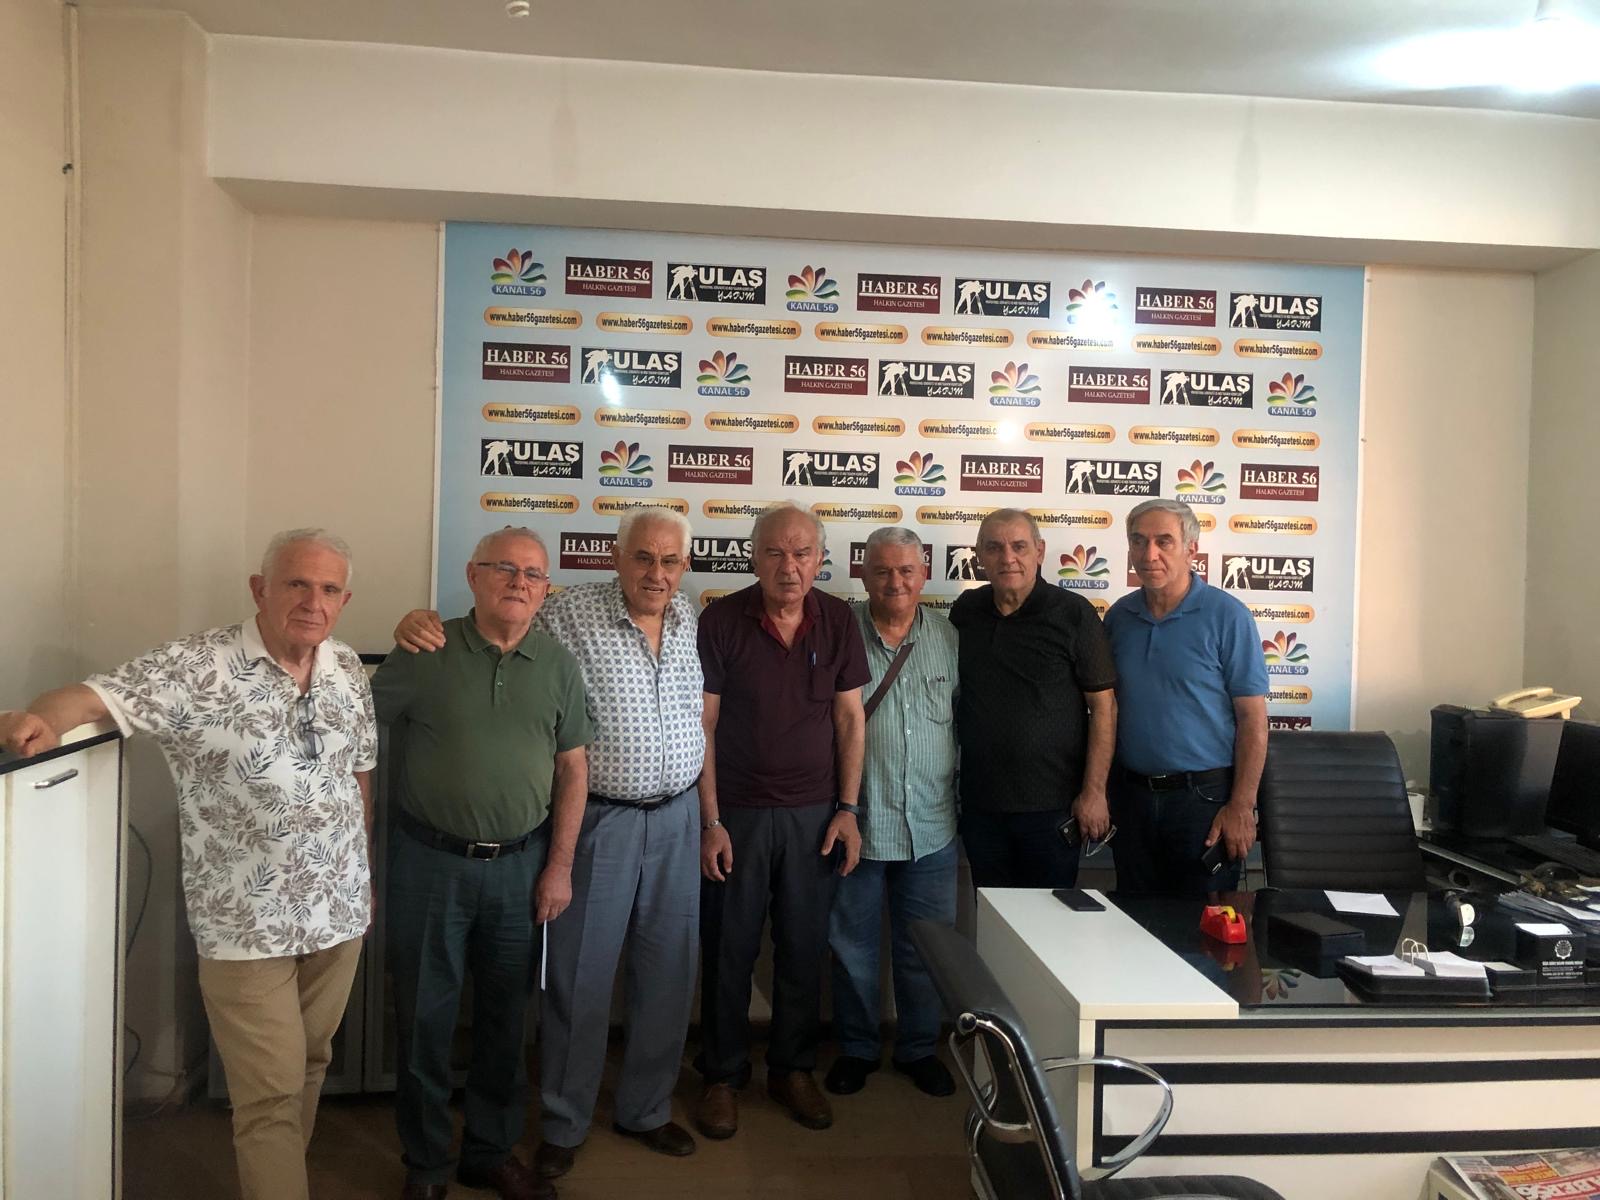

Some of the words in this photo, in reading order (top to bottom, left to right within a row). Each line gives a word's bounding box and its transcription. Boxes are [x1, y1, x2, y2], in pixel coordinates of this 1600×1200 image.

[569, 263, 629, 280] HABER
[633, 266, 650, 281] 56
[699, 267, 763, 288] ULAŞ
[495, 285, 528, 296] KANAL
[529, 286, 542, 296] 56
[582, 282, 606, 292] HALKIN
[860, 279, 917, 295] HABER
[921, 282, 938, 296] 56
[985, 282, 1048, 303] ULAŞ
[790, 302, 822, 312] KANAL
[823, 303, 835, 312] 56
[873, 299, 896, 308] HALKIN
[1139, 293, 1193, 309] HABER
[1198, 296, 1214, 310] 56
[1259, 296, 1319, 317] ULAŞ
[489, 312, 578, 326] www.haber56gazetesi.com
[1151, 312, 1173, 320] HALKIN
[601, 317, 688, 332] www.haber56gazetesi.com
[711, 322, 797, 337] www.haber56gazetesi.com
[820, 327, 904, 341] www.haber56gazetesi.com
[926, 331, 1009, 345] www.haber56gazetesi.com
[1136, 339, 1217, 352] www.haber56gazetesi.com
[1239, 343, 1318, 357] www.haber56gazetesi.com
[486, 349, 545, 365] HABER
[550, 351, 568, 366] 56
[613, 351, 679, 372] ULAŞ
[500, 368, 523, 376] HALKIN
[788, 361, 845, 377] HABER
[849, 364, 866, 378] 56
[909, 364, 971, 385] ULAŞ
[801, 381, 824, 389] HALKIN
[1072, 372, 1126, 387] HABER
[1132, 374, 1148, 388] 56
[1190, 374, 1250, 395] ULAŞ
[701, 386, 733, 396] KANAL
[734, 388, 746, 397] 56
[1084, 391, 1105, 399] HALKIN
[993, 397, 1025, 406] KANAL
[1026, 398, 1037, 406] 56
[487, 408, 576, 422] www.haber56gazetesi.com
[1271, 407, 1300, 416] KANAL
[1301, 407, 1313, 417] 56
[600, 412, 686, 427] www.haber56gazetesi.com
[709, 416, 795, 431] www.haber56gazetesi.com
[817, 420, 901, 434] www.haber56gazetesi.com
[924, 425, 997, 439] www.haber56gazetesi.c
[1029, 428, 1111, 442] www.haber56gazetesi.com
[1133, 430, 1215, 444] www.haber56gazetesi.com
[1237, 434, 1316, 448] www.haber56gazetesi.com
[514, 442, 580, 464] ULAŞ
[672, 451, 729, 467] HABER
[733, 453, 751, 467] 56
[814, 454, 876, 474] ULAŞ
[964, 461, 1020, 476] HABER
[1025, 463, 1041, 476] 56
[685, 470, 708, 479] HALKIN
[1096, 462, 1158, 484] ULAŞ
[1243, 470, 1297, 484] HABER
[1301, 471, 1317, 485] 56
[603, 477, 635, 487] KANAL
[636, 478, 648, 488] 56
[976, 479, 999, 487] HALKIN
[898, 486, 930, 496] KANAL
[930, 487, 942, 496] 56
[1255, 488, 1278, 496] HALKIN
[486, 496, 574, 510] www.haber56gazetesi.com
[1179, 494, 1209, 503] KANAL
[1210, 495, 1222, 504] 56
[815, 507, 898, 522] www.haber56gazetesi.com
[921, 511, 988, 525] www.haber56gazetesi
[1034, 514, 1108, 528] w.haber56gazetesi.com
[1233, 520, 1313, 534] www.haber56gazetesi.com
[564, 538, 615, 553] HABE
[577, 557, 601, 565] HALKIN
[1252, 558, 1311, 578] ULAŞ
[1062, 579, 1093, 588] KANAL
[1094, 580, 1105, 589] 56
[1250, 608, 1310, 621] aber56gazetesi.com
[1268, 665, 1293, 674] ANAL
[1294, 666, 1305, 675] 56
